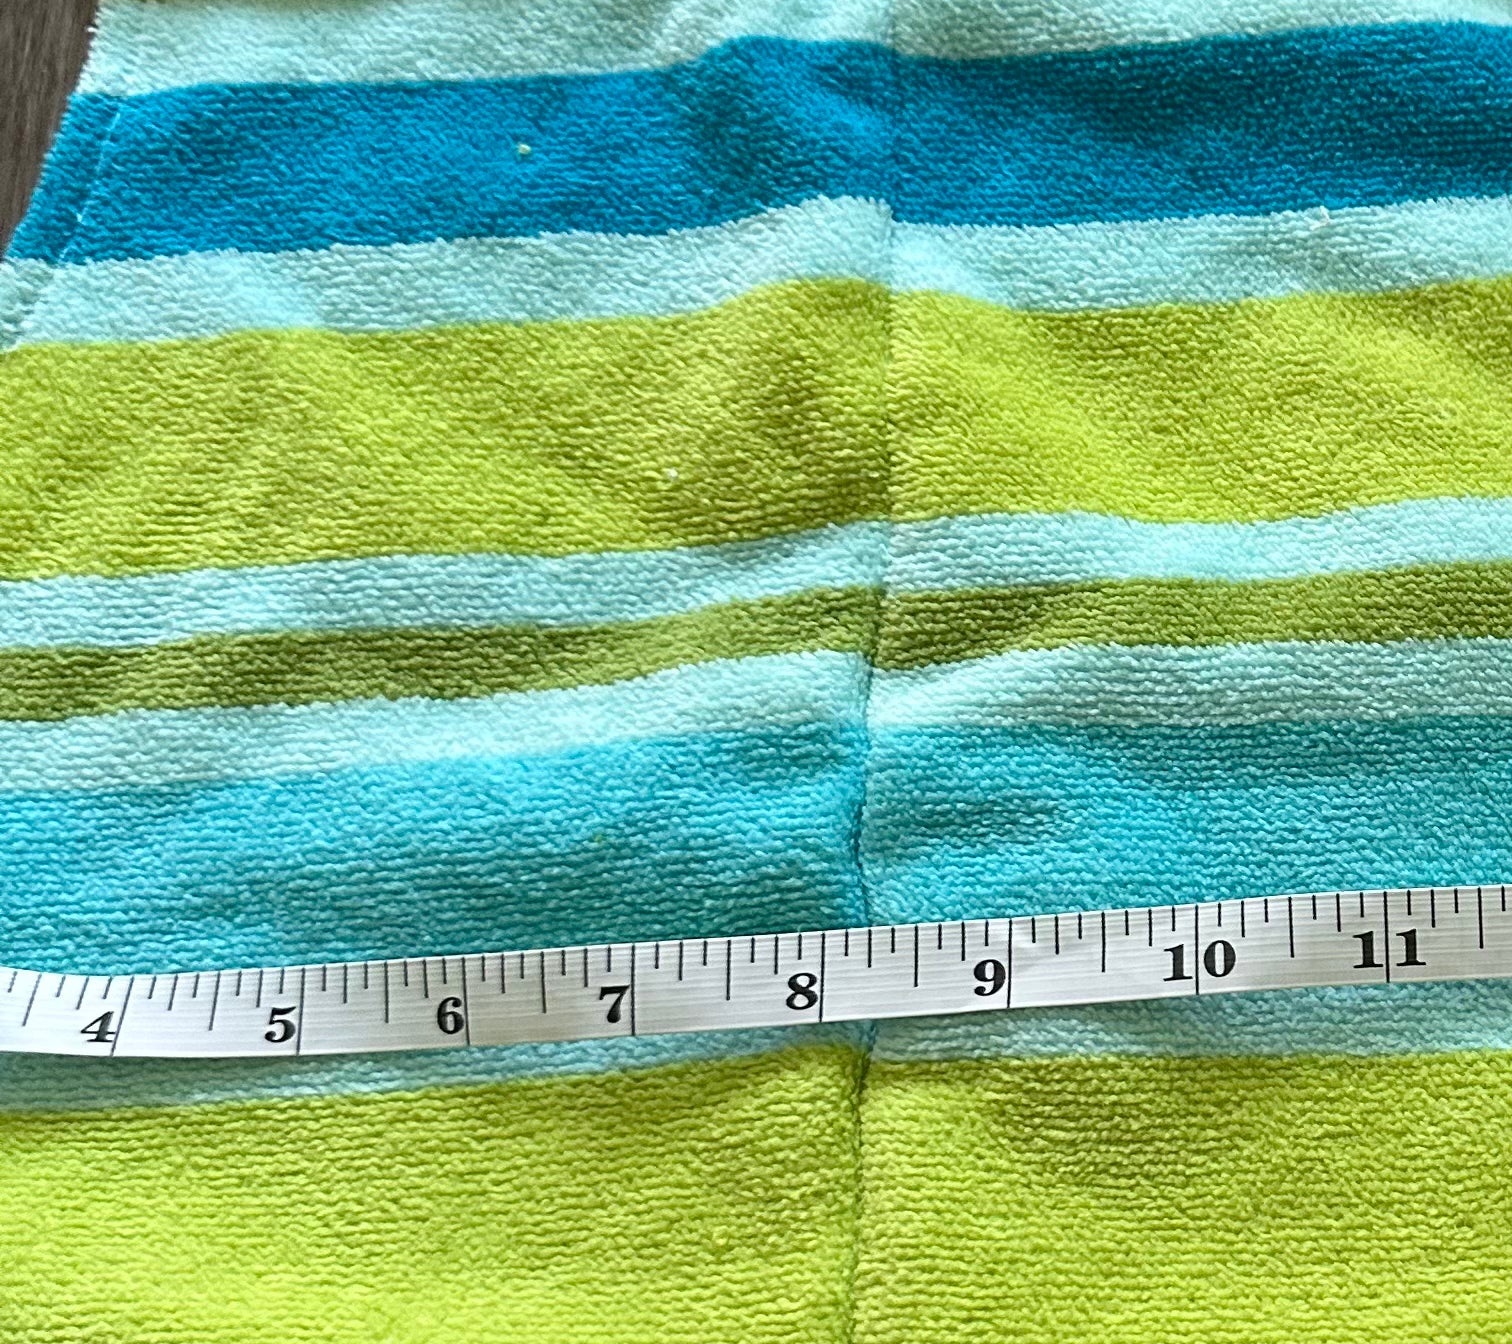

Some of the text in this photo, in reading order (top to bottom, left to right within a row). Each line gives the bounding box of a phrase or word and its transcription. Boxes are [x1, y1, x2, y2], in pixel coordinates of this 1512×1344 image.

[80, 1011, 116, 1043] 4
[264, 1006, 297, 1043] 5
[436, 996, 465, 1035] 6
[598, 984, 630, 1024] 7
[785, 972, 818, 1011] 8
[973, 959, 1006, 997] 9
[1163, 939, 1236, 982] 10
[1352, 928, 1427, 969] 11
